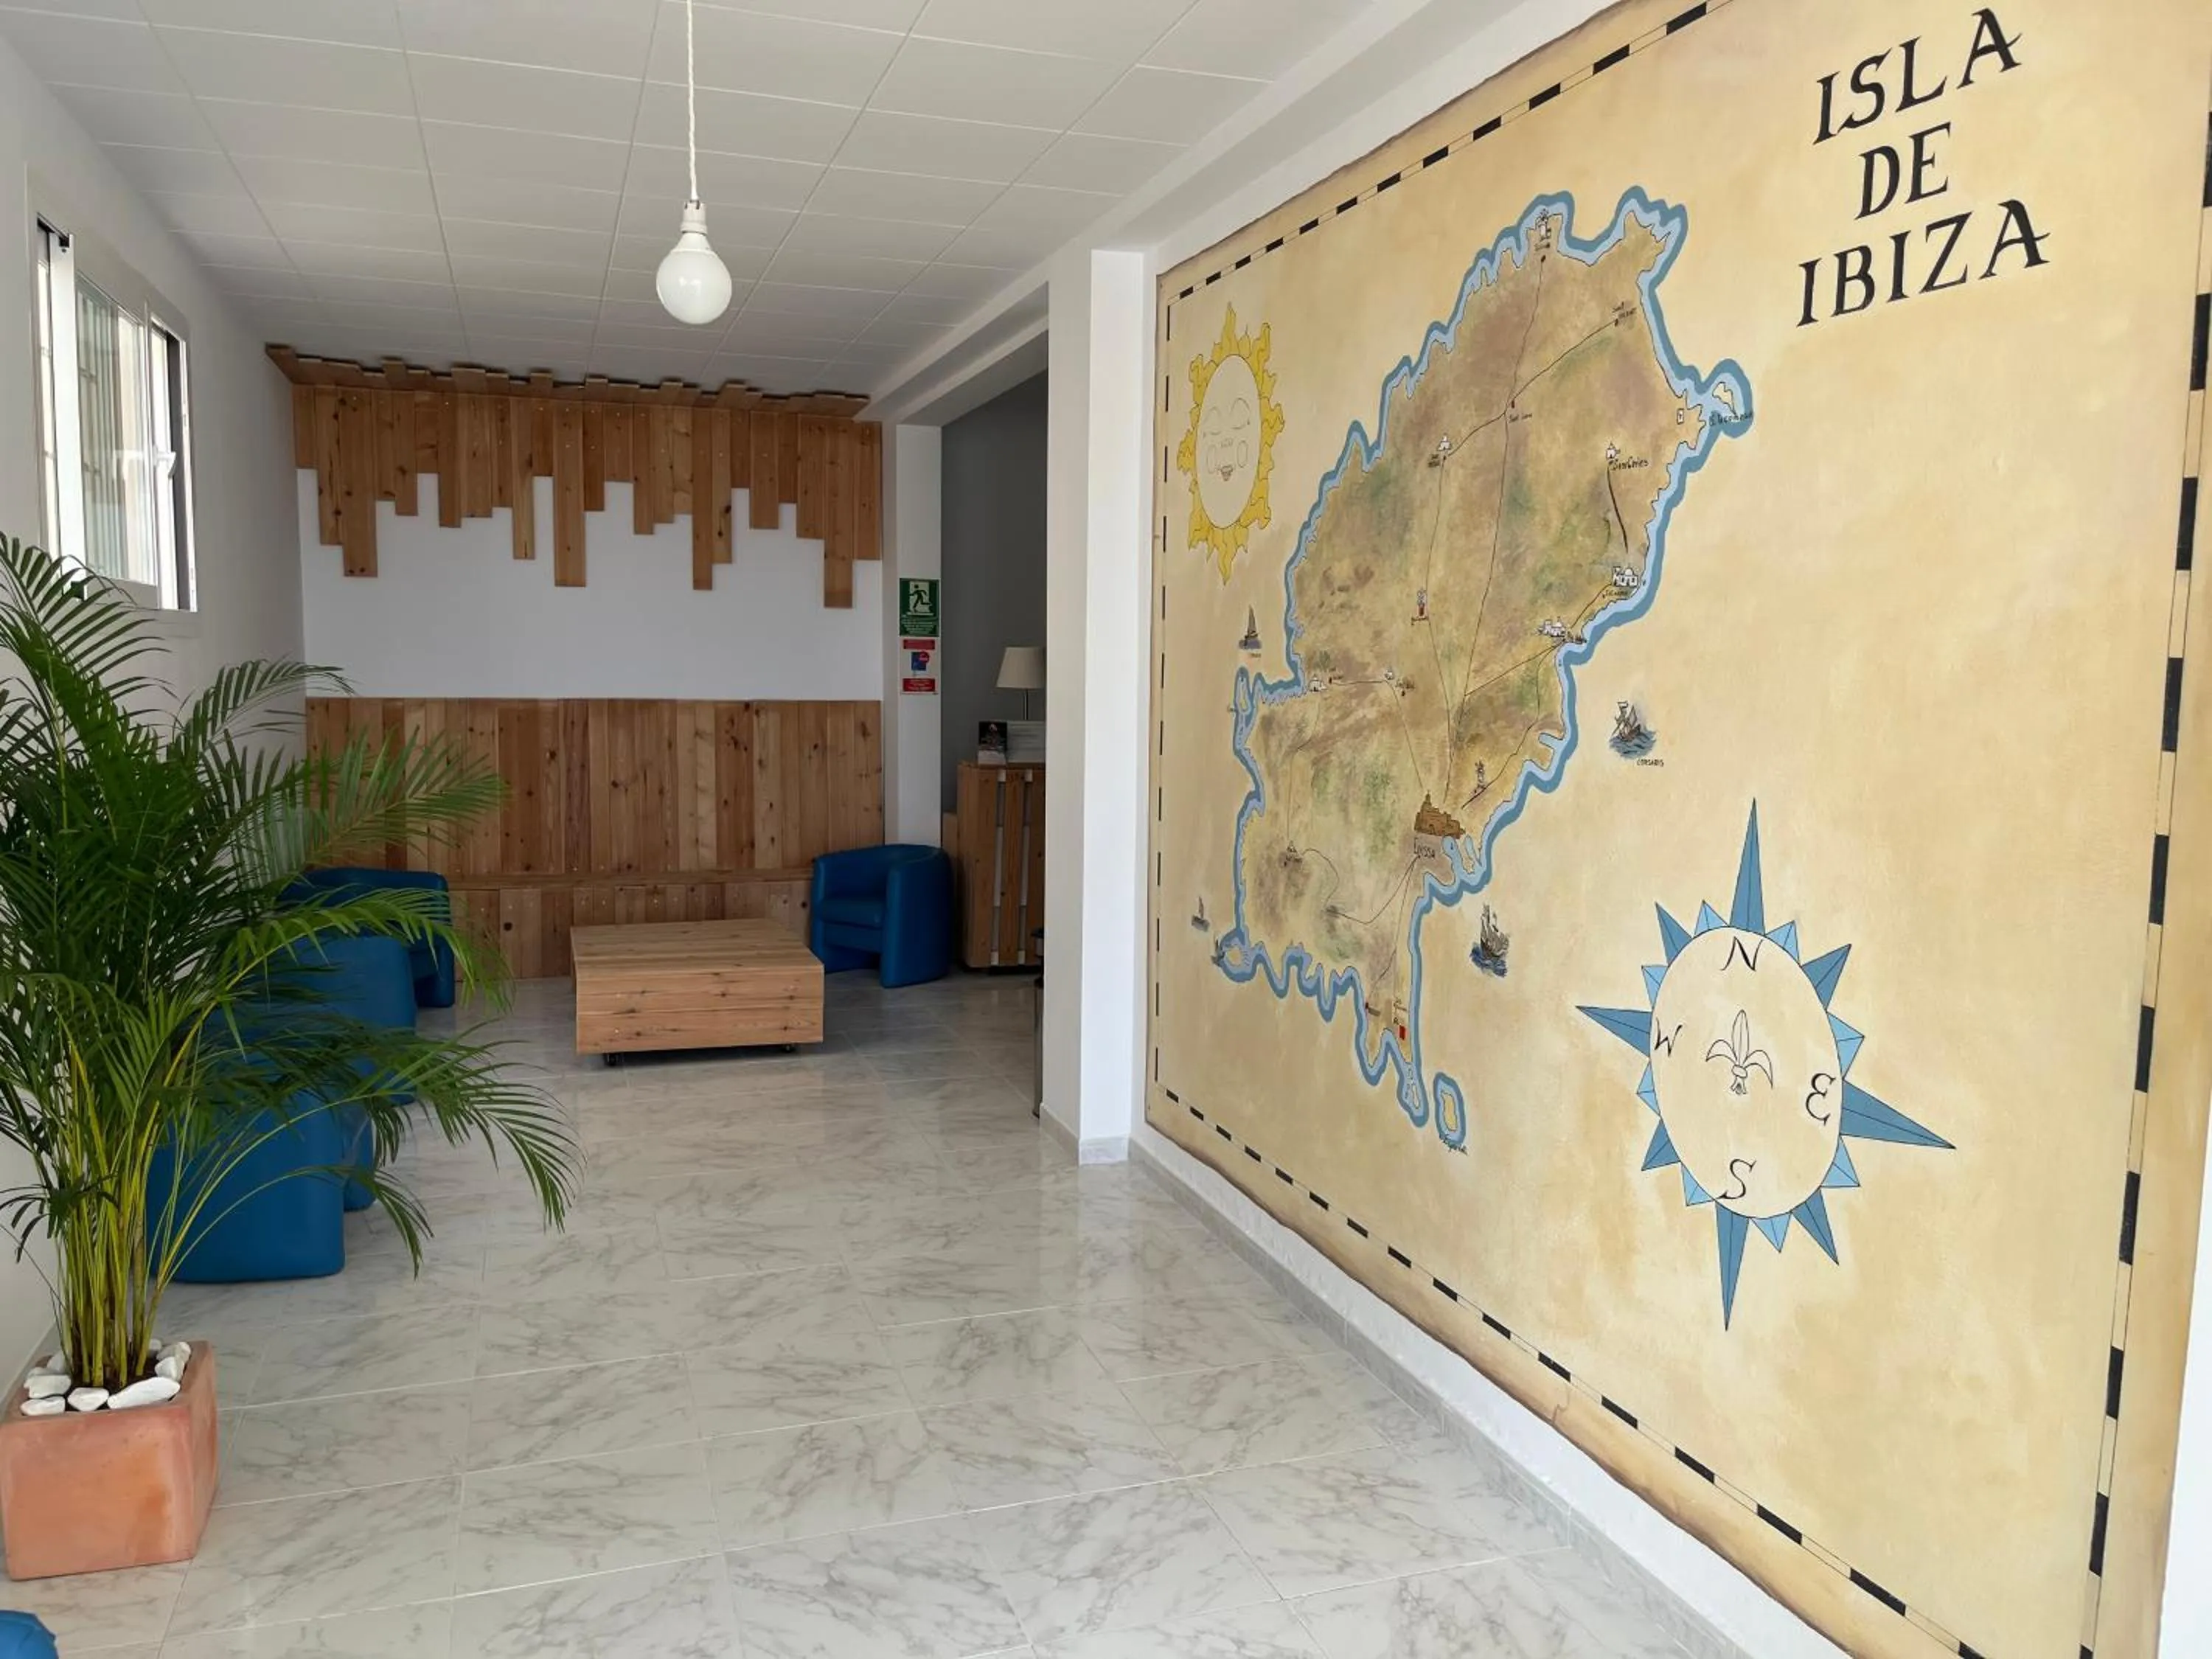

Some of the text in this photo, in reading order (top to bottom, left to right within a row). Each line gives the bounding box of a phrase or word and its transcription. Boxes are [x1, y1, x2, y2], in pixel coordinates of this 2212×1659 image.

[1812, 7, 2023, 145] ISLA
[1854, 122, 1952, 220] DE
[1795, 199, 2051, 328] IBIZA
[1720, 936, 1764, 971] N
[1654, 1016, 1682, 1057] W
[1805, 1073, 1836, 1126] E
[1719, 1158, 1756, 1200] S
